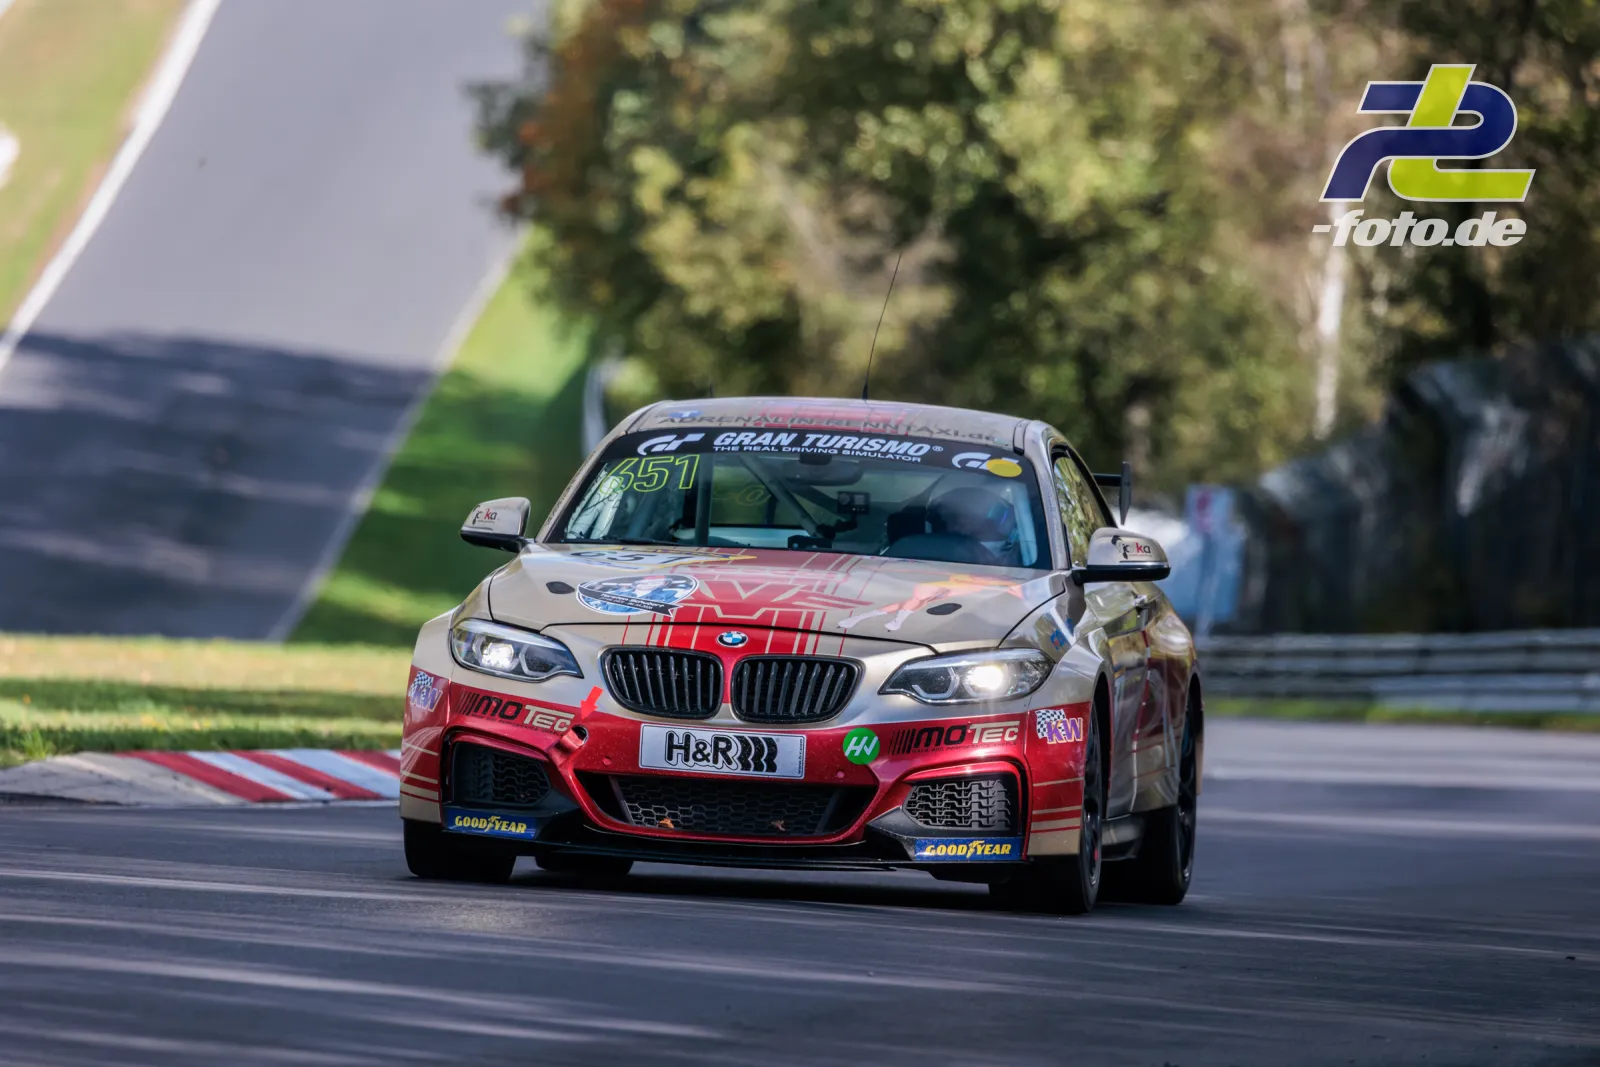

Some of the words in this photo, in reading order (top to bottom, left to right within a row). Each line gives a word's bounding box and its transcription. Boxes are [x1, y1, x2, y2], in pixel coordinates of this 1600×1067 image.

[713, 432, 798, 446] GRAN
[846, 450, 921, 463] SIMULATOR
[600, 454, 701, 494] 651
[1046, 717, 1083, 745] KW
[666, 731, 738, 770] H&R
